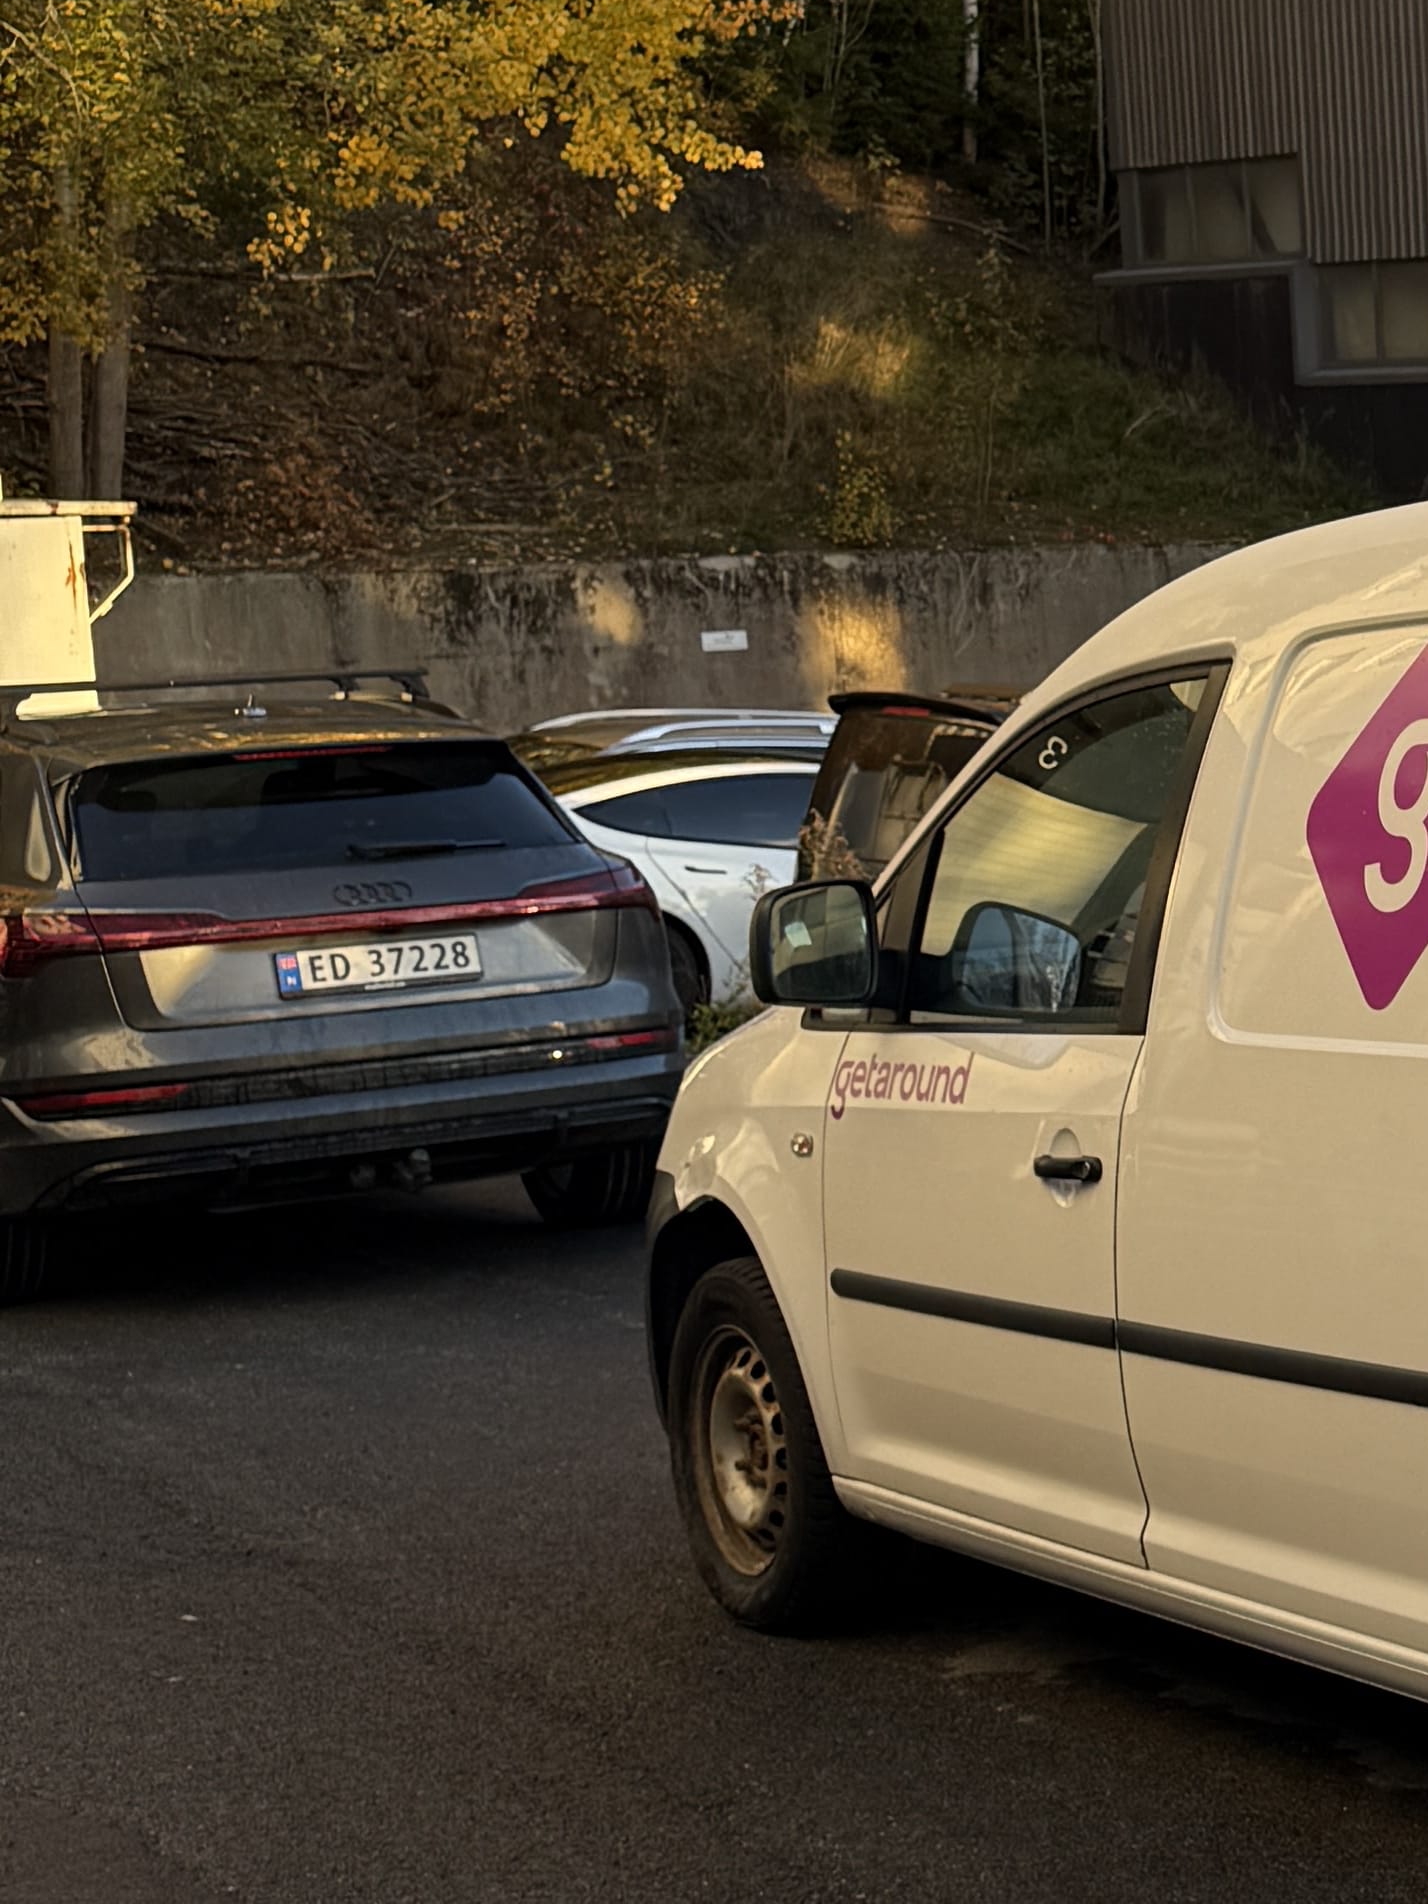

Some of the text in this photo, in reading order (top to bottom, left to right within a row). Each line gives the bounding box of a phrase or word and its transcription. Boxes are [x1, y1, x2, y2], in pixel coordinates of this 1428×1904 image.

[309, 941, 470, 983] ED 37228
[831, 1052, 974, 1120] getaround
